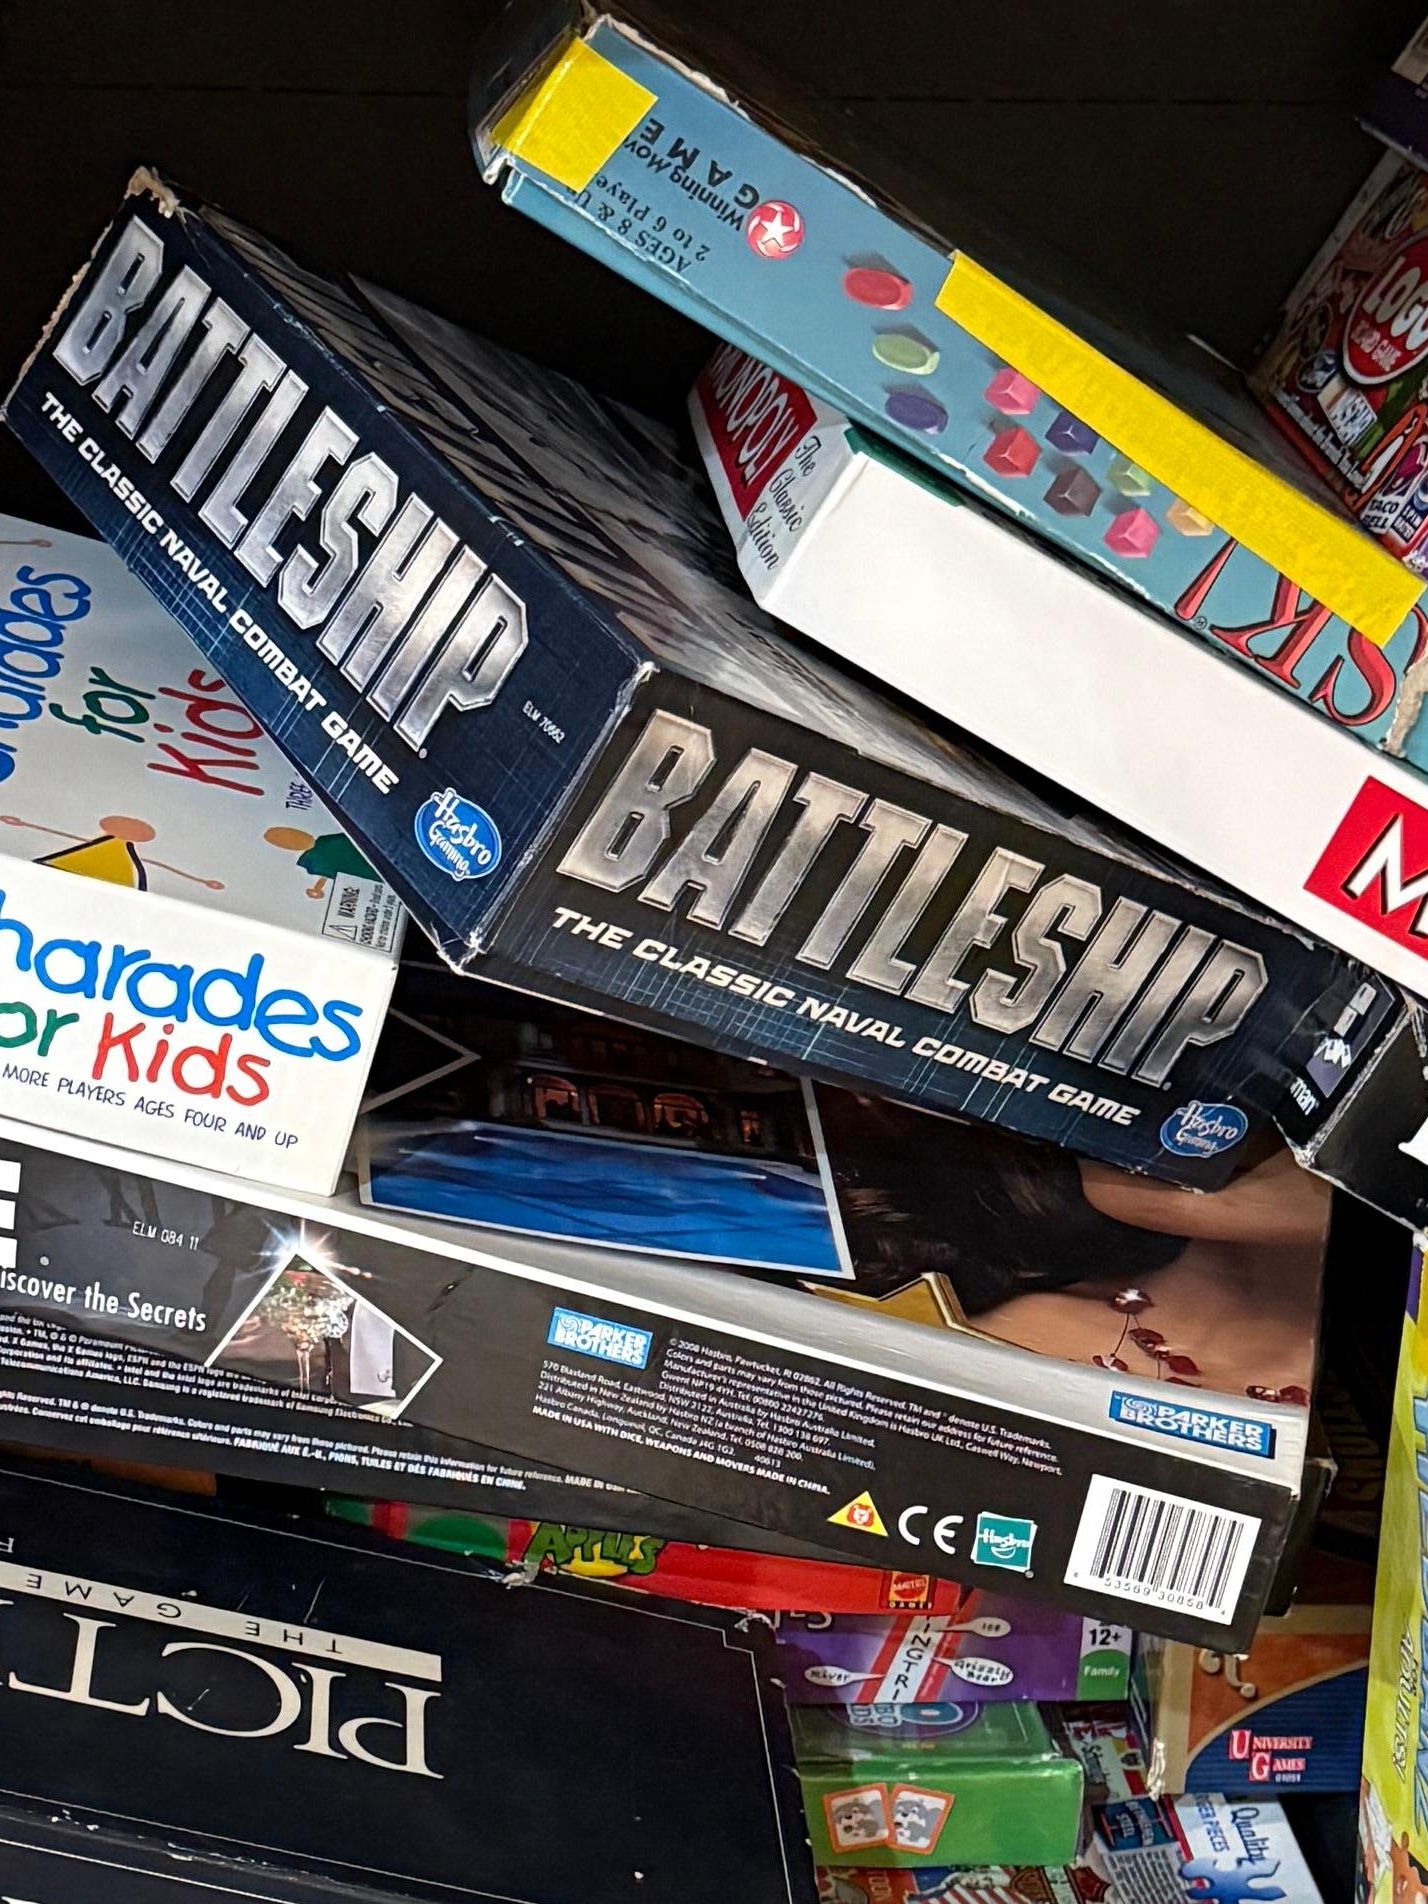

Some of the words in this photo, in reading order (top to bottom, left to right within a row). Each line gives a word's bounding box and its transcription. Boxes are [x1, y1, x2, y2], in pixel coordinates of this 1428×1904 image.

[639, 118, 760, 209] GAME
[50, 214, 530, 755] BATTLESHIP
[40, 391, 79, 445] THE
[76, 442, 163, 538] CLASSIC
[159, 527, 230, 611] NAVAL
[228, 609, 326, 711] COMBAT
[320, 709, 399, 796] GAME
[554, 707, 1270, 1093] BATTLESHIP
[91, 1012, 271, 1106] Kids
[552, 905, 626, 950] THE
[632, 936, 799, 1009] CLASSIC
[797, 996, 908, 1051] NAVAL
[911, 1034, 1052, 1097] COMBAT
[1046, 1079, 1142, 1127] GAME
[2, 1064, 51, 1090] MORE
[57, 1076, 126, 1110] PLAYERS
[135, 1095, 175, 1121] AGES
[183, 1108, 228, 1134] FOUR
[235, 1120, 268, 1142] AND
[275, 1130, 299, 1149] UP
[83, 1277, 121, 1316] the
[127, 1290, 208, 1334] Secrets
[1083, 1664, 1121, 1678] Family
[1088, 1627, 1122, 1647] 12+
[1231, 1807, 1270, 1865] Quality
